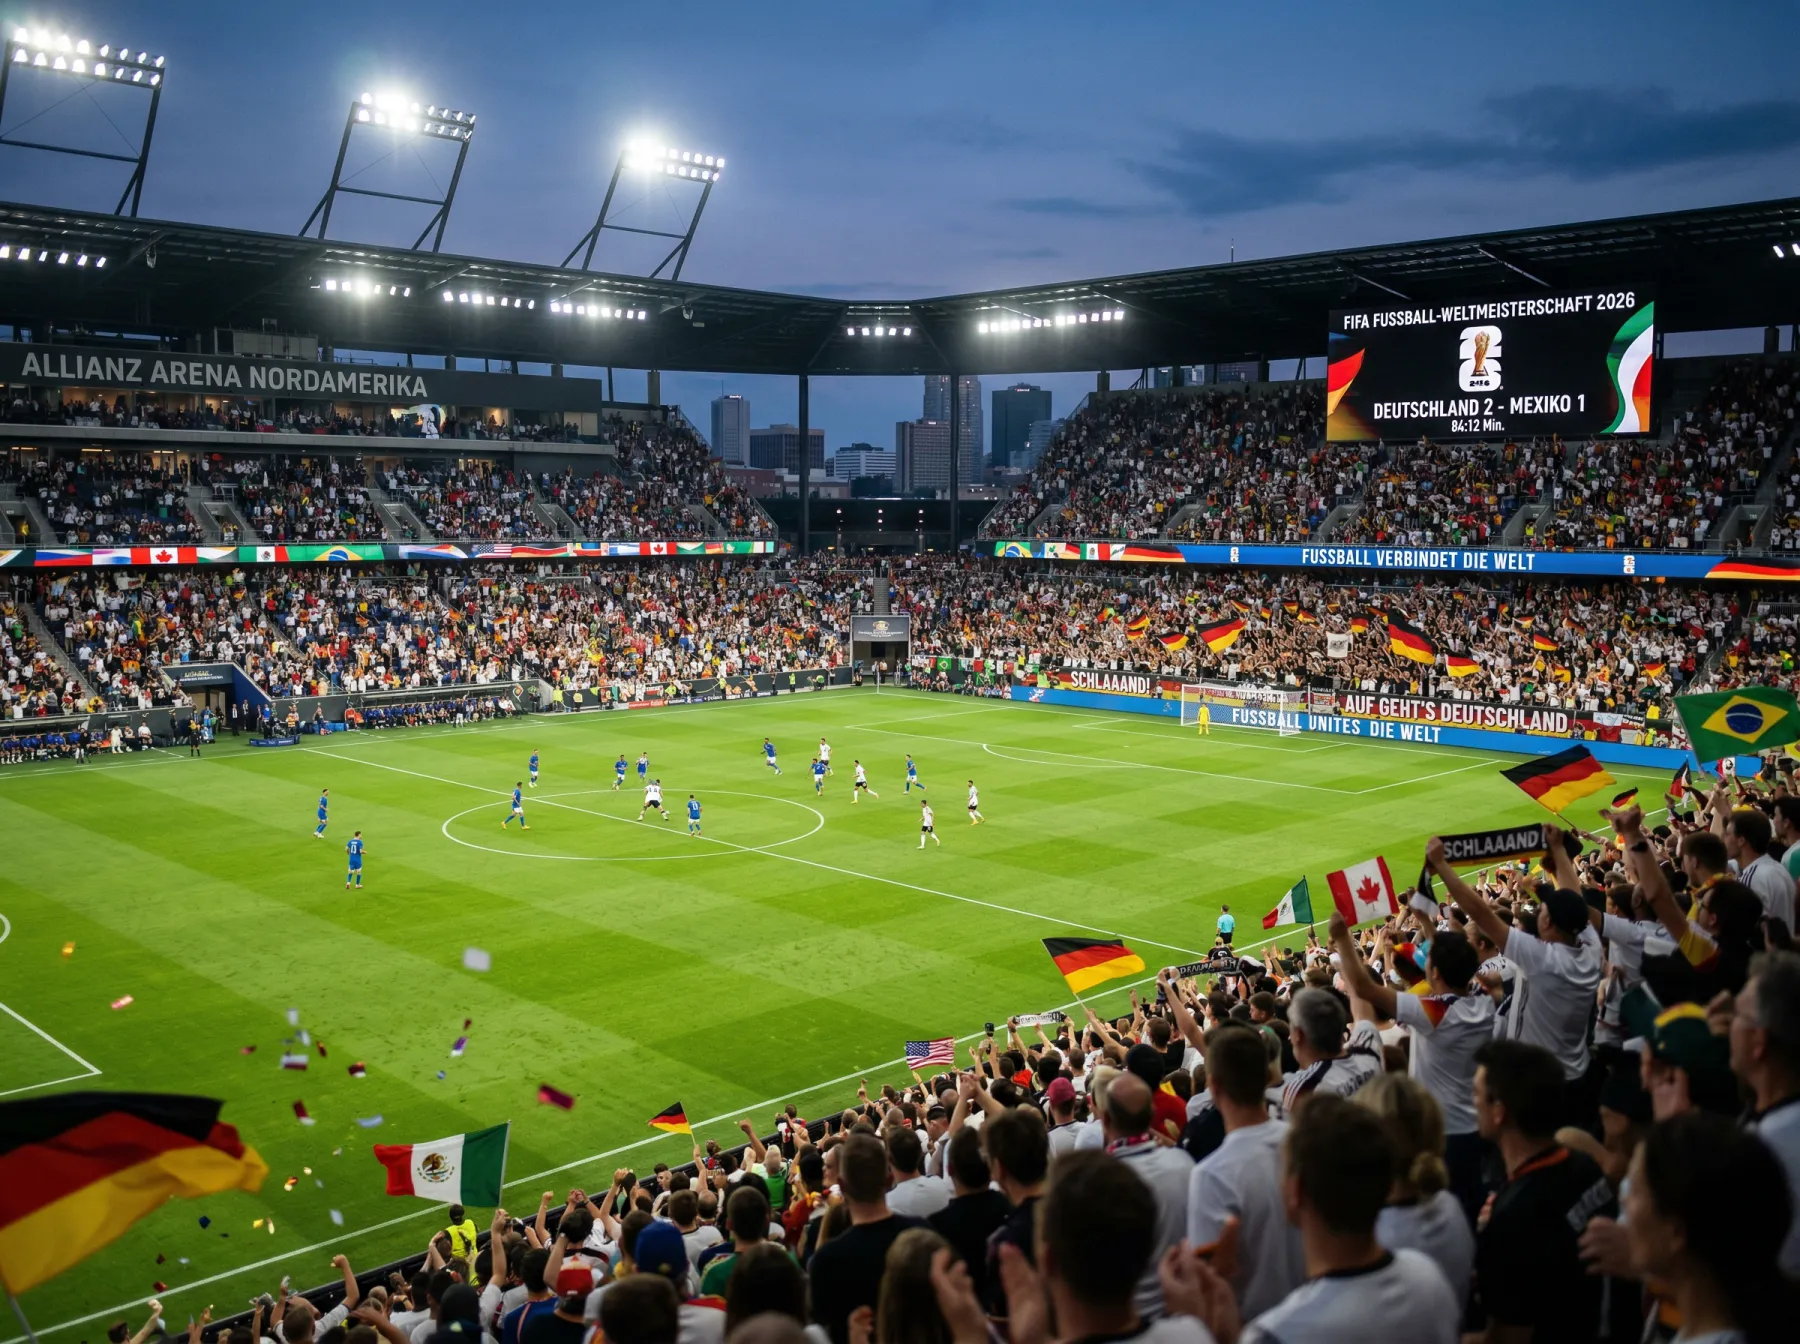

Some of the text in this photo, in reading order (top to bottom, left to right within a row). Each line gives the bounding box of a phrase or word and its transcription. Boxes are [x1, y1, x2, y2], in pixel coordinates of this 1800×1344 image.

[1344, 291, 1636, 330] FIFA FUSSBALL-WELTMEISTERSCHAFT 2026
[21, 352, 428, 398] ALLIANZ ARENA NORDAMERIKA
[1373, 398, 1479, 420] DEUTSCHLAND
[1483, 398, 1494, 416] 2
[1510, 394, 1571, 415] MEXIKO
[1577, 394, 1586, 412] 1
[1451, 418, 1505, 433] 84:12 Min.
[1302, 547, 1536, 571] FUSSBALL VERBINDET DIE WELT
[1070, 670, 1151, 695] SCHLAAAND!
[1232, 707, 1442, 744] FUSSBALL UNITES DIE WELT
[1344, 694, 1569, 734] AUF GEHT'S DEUTSCHLAND
